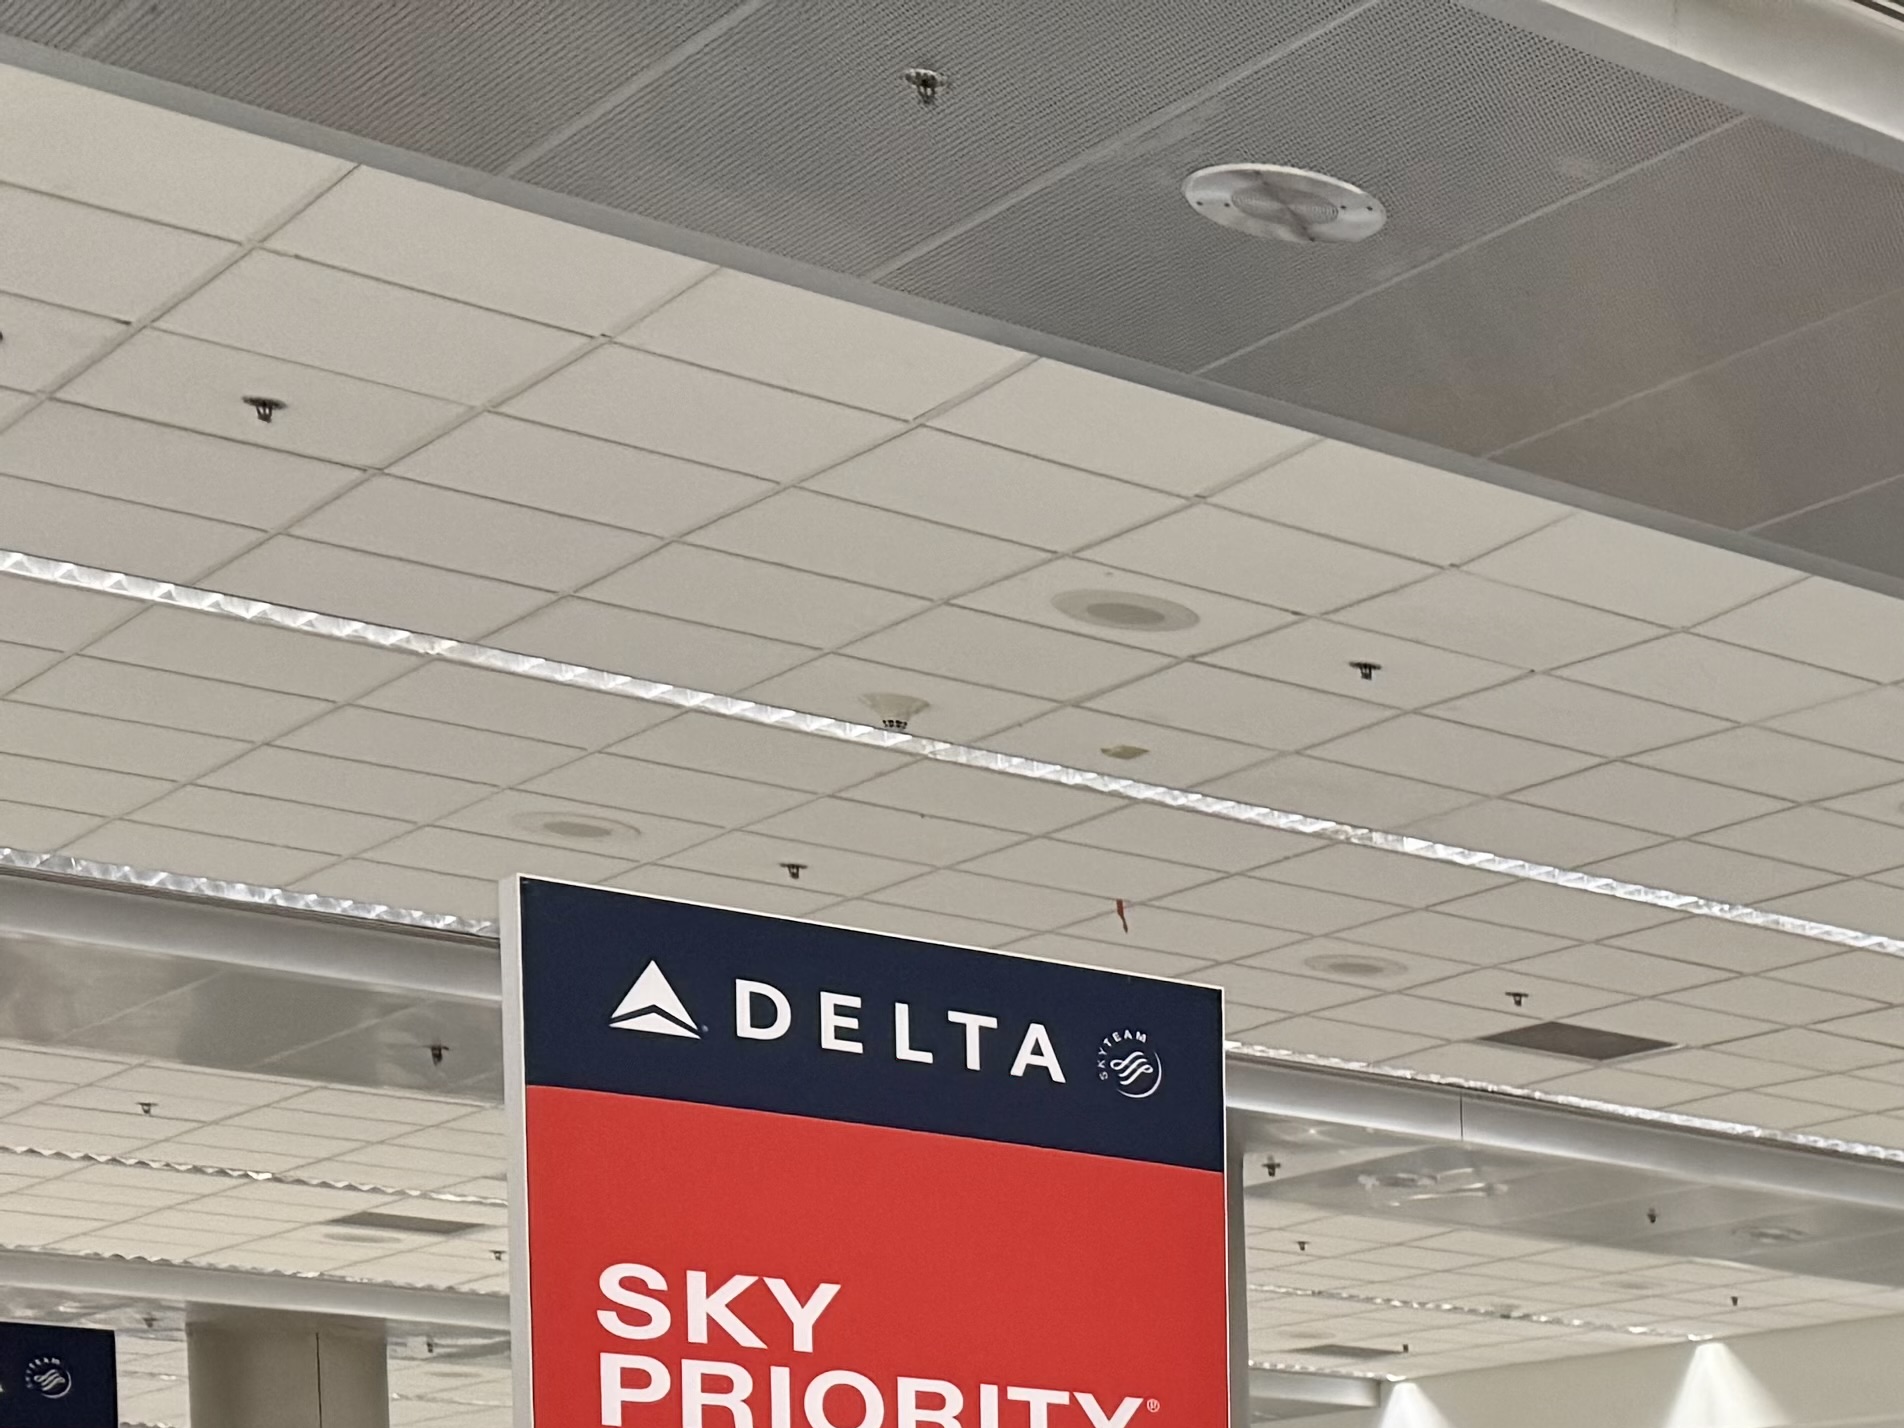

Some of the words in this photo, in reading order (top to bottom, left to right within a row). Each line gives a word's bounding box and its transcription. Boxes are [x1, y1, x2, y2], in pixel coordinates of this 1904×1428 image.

[736, 979, 1065, 1083] DELTA
[1098, 1029, 1148, 1082] SKYTEAM
[597, 1263, 841, 1352] SKY
